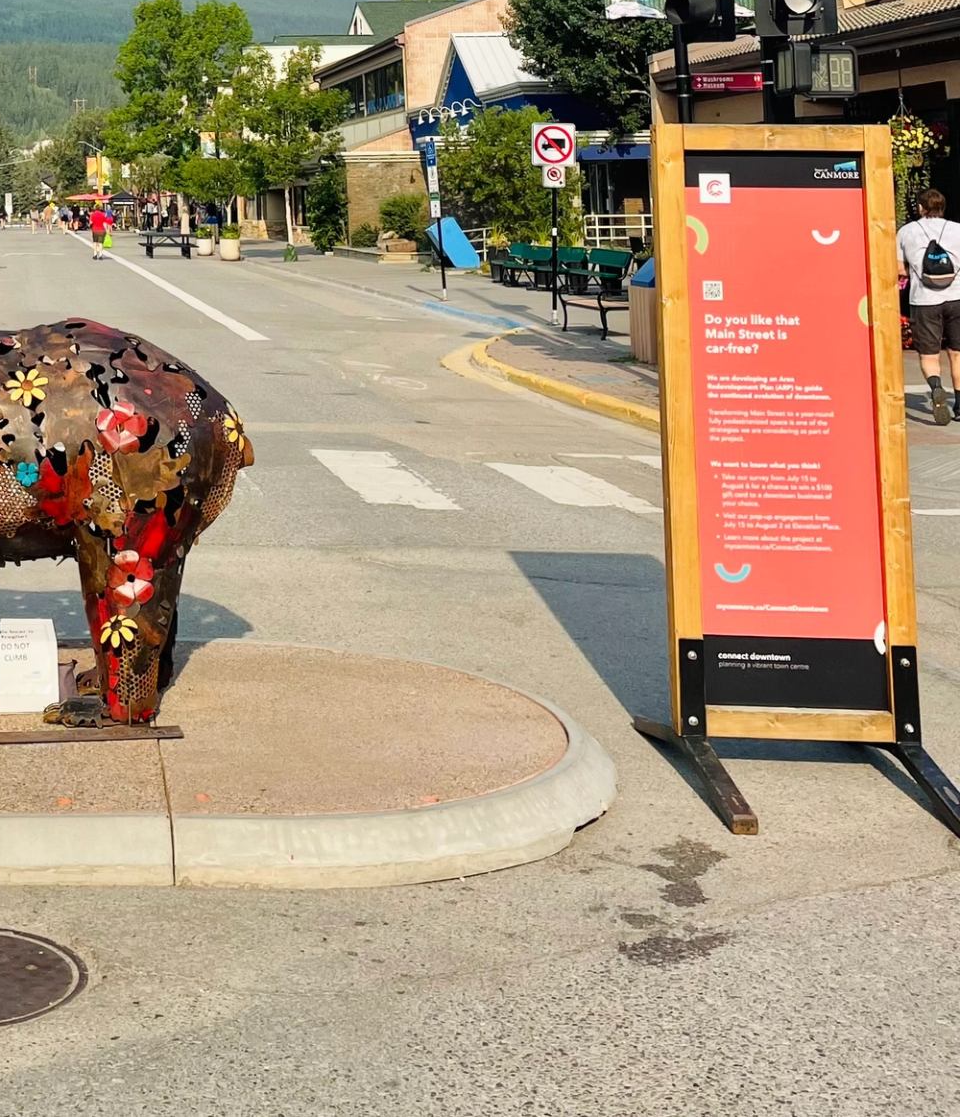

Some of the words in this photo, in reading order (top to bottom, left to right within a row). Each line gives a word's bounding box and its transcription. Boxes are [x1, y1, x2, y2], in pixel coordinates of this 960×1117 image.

[704, 314, 722, 324] Do
[725, 316, 747, 327] you
[751, 314, 772, 325] like
[775, 315, 800, 325] that
[705, 329, 735, 339] Main
[739, 329, 775, 339] Street
[778, 329, 787, 340] is
[706, 342, 759, 354] car-free?
[4, 654, 28, 662] CLIMB
[718, 652, 749, 660] connect
[750, 652, 791, 661] downtown
[718, 662, 746, 670] planning
